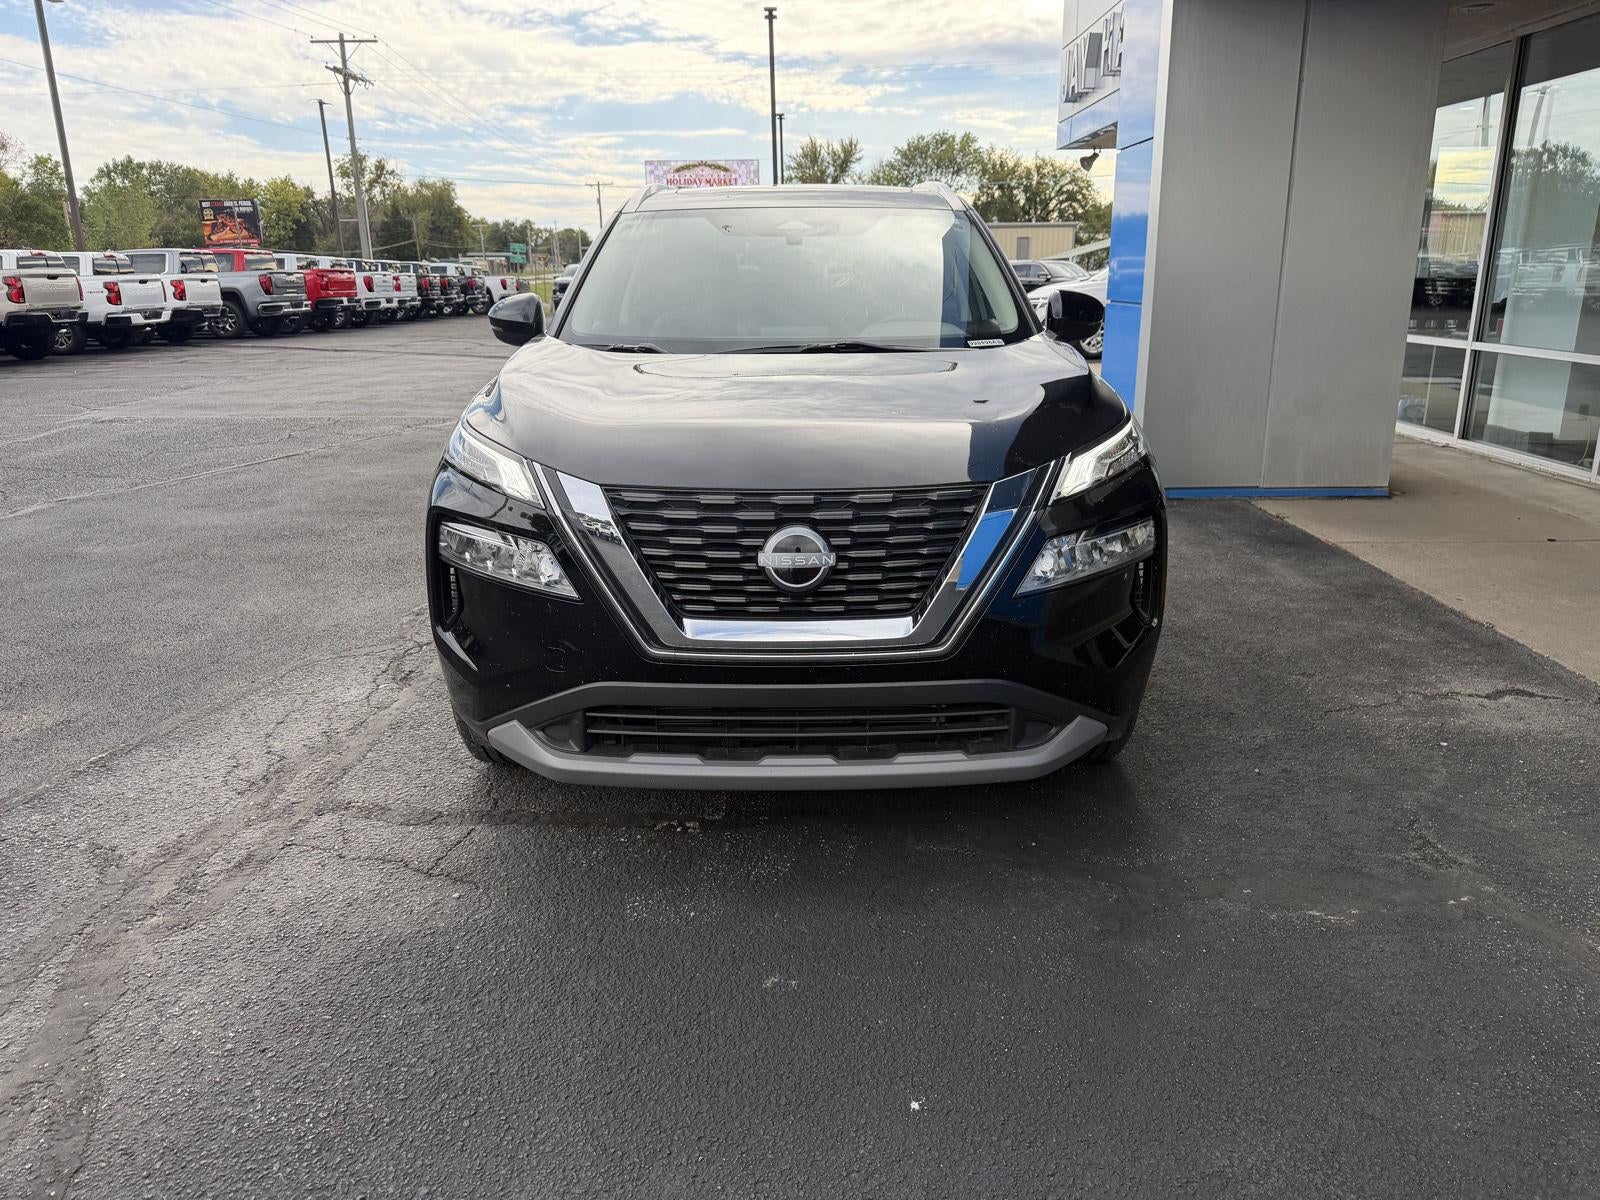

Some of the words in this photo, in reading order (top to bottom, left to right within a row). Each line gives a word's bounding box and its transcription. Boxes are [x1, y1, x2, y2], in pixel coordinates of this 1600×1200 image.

[1061, 33, 1090, 103] JAY
[666, 178, 702, 186] HOLIDAY
[705, 178, 738, 187] MARKET
[760, 555, 833, 565] NISSAN
